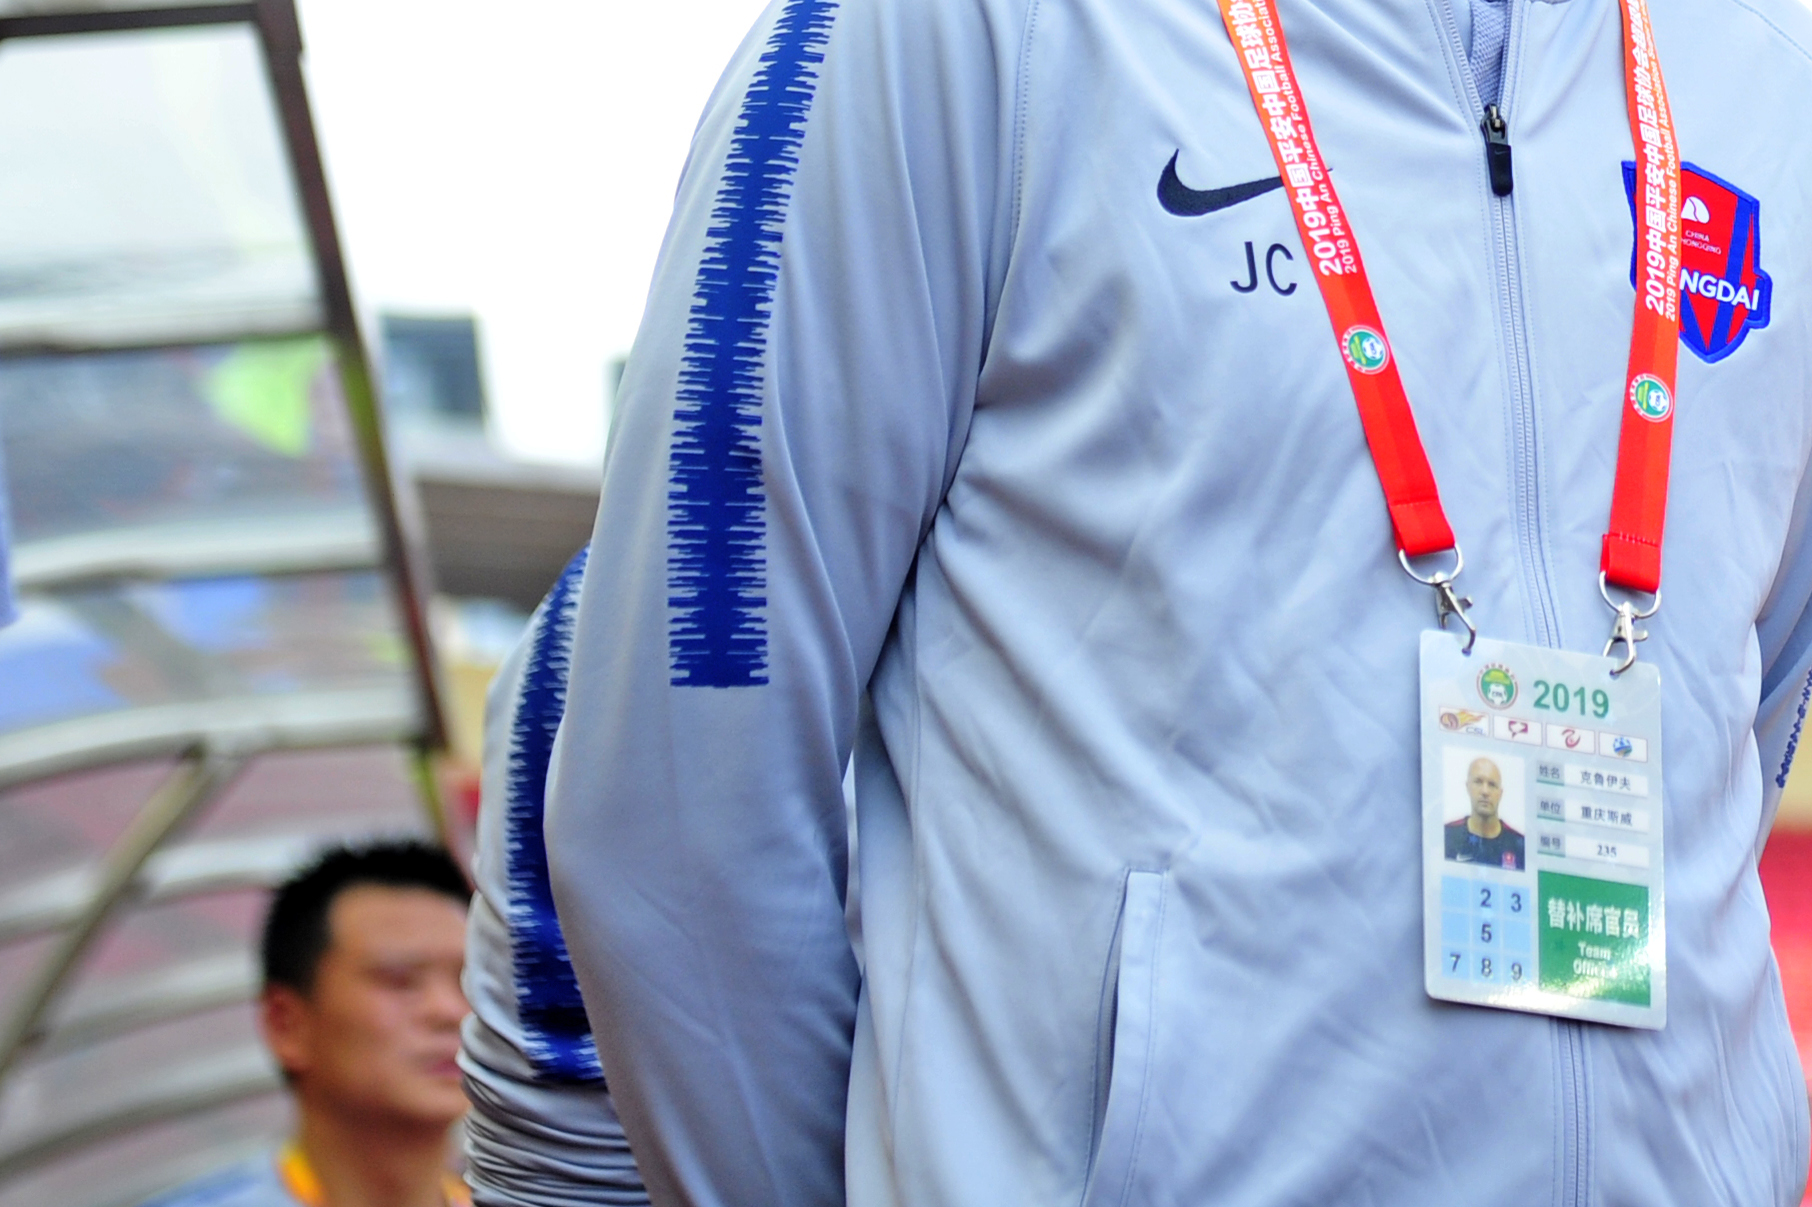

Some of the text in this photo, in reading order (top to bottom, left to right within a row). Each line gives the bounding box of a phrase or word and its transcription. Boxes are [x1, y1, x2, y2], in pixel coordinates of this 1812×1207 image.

[1273, 65, 1303, 121] Football
[1298, 124, 1324, 181] Chinese
[1660, 127, 1677, 178] Football
[1318, 183, 1333, 203] An
[1666, 179, 1678, 232] Chinese
[1326, 205, 1346, 236] Ping
[1685, 230, 1710, 243] CHINA
[1336, 239, 1357, 274] 2019
[1667, 235, 1678, 255] An
[1230, 241, 1298, 297] JC
[1666, 255, 1679, 287] Ping
[1665, 288, 1677, 322] 2019
[1680, 267, 1760, 311] NGDAI
[1532, 679, 1610, 720] 2019
[1539, 764, 1631, 791] 姓名 克鲁伊夫
[1540, 800, 1633, 827] 单位 重庆斯威
[1480, 888, 1522, 913] 2 3
[1481, 923, 1492, 943] 5
[1548, 897, 1640, 939] 替补席官员
[1578, 941, 1611, 960] Team
[1450, 953, 1522, 982] 7 8 9
